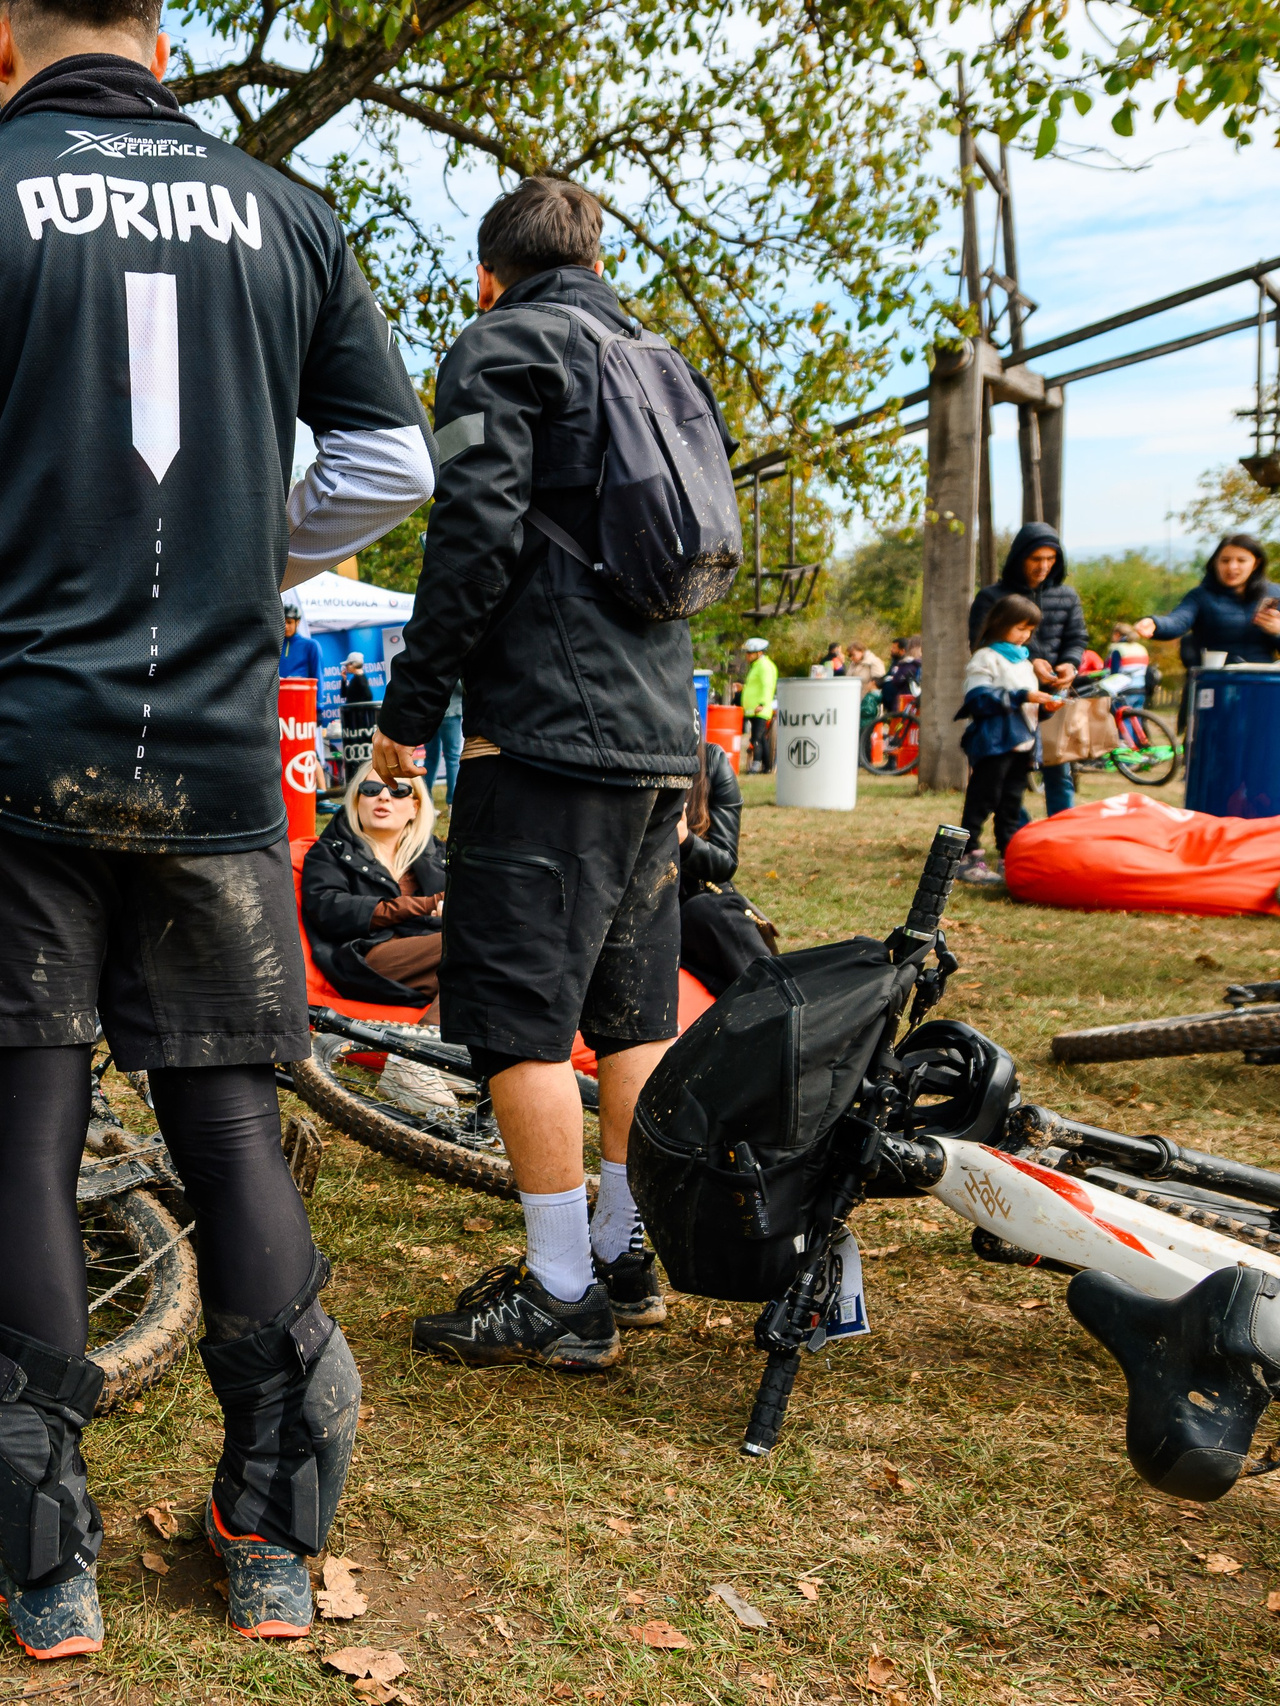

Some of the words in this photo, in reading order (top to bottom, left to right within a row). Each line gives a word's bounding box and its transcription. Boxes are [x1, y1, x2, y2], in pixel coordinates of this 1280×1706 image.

[55, 130, 208, 160] XPERIENCE
[123, 136, 154, 145] TRIADA
[16, 172, 262, 250] ADRIAN
[152, 518, 162, 598] JOIN
[148, 627, 158, 677] THE
[342, 726, 378, 739] Nurvi
[779, 708, 838, 727] Nurvil
[134, 704, 151, 780] RIDE
[790, 740, 817, 766] MG
